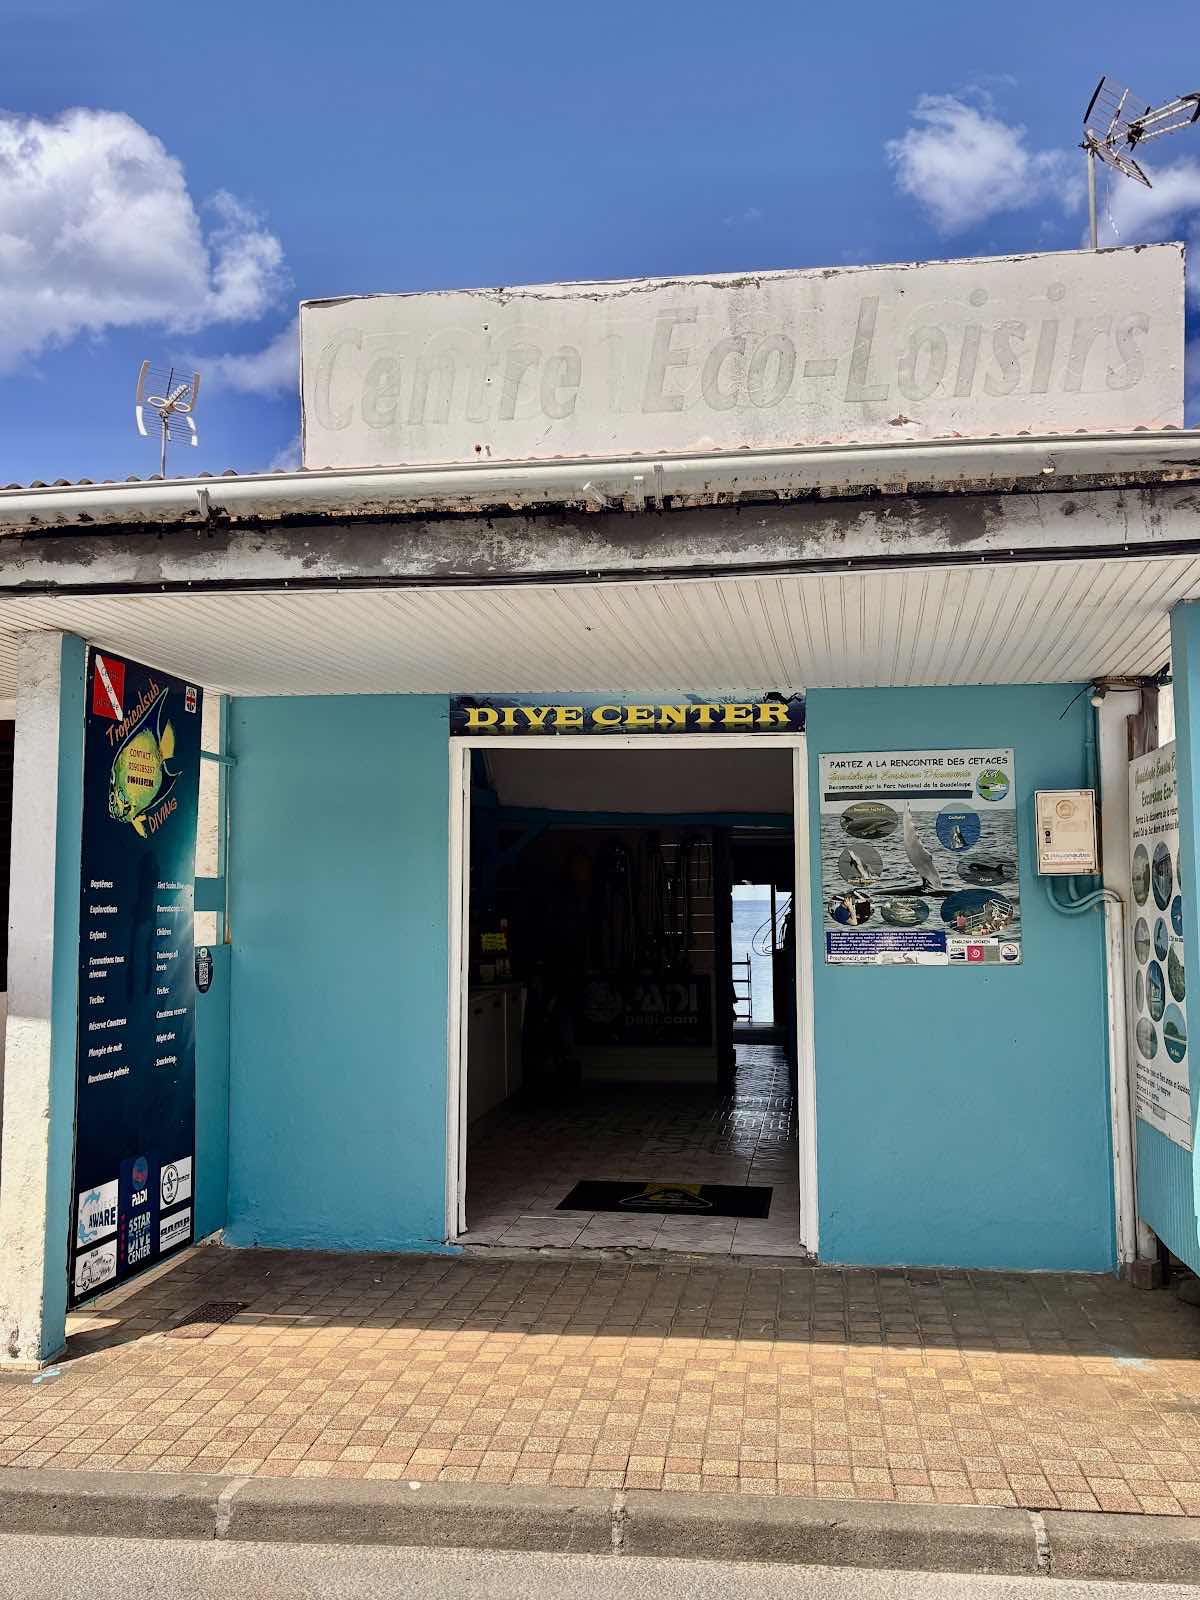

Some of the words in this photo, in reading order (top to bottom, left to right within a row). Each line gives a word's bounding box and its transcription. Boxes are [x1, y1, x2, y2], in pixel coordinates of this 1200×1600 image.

[315, 327, 582, 431] Centre
[641, 282, 1150, 414] Eco-Loisirs
[106, 678, 160, 746] Tropicalsub
[464, 706, 584, 727] DIVE
[591, 703, 791, 727] CENTER
[830, 760, 863, 768] PARTEZ
[866, 760, 872, 768] A
[876, 759, 887, 768] LA
[890, 758, 944, 767] RENCONTRE
[947, 757, 965, 766] DES
[968, 756, 1008, 765] CETACES
[148, 797, 178, 834] DIVING
[90, 880, 114, 890] Baptêmes
[90, 905, 118, 915] Explorations
[90, 931, 107, 941] Enfants
[88, 1046, 106, 1058] Plongée
[132, 1188, 148, 1207] PADI
[88, 1206, 116, 1228] AWARE
[128, 1244, 151, 1264] CENTER
